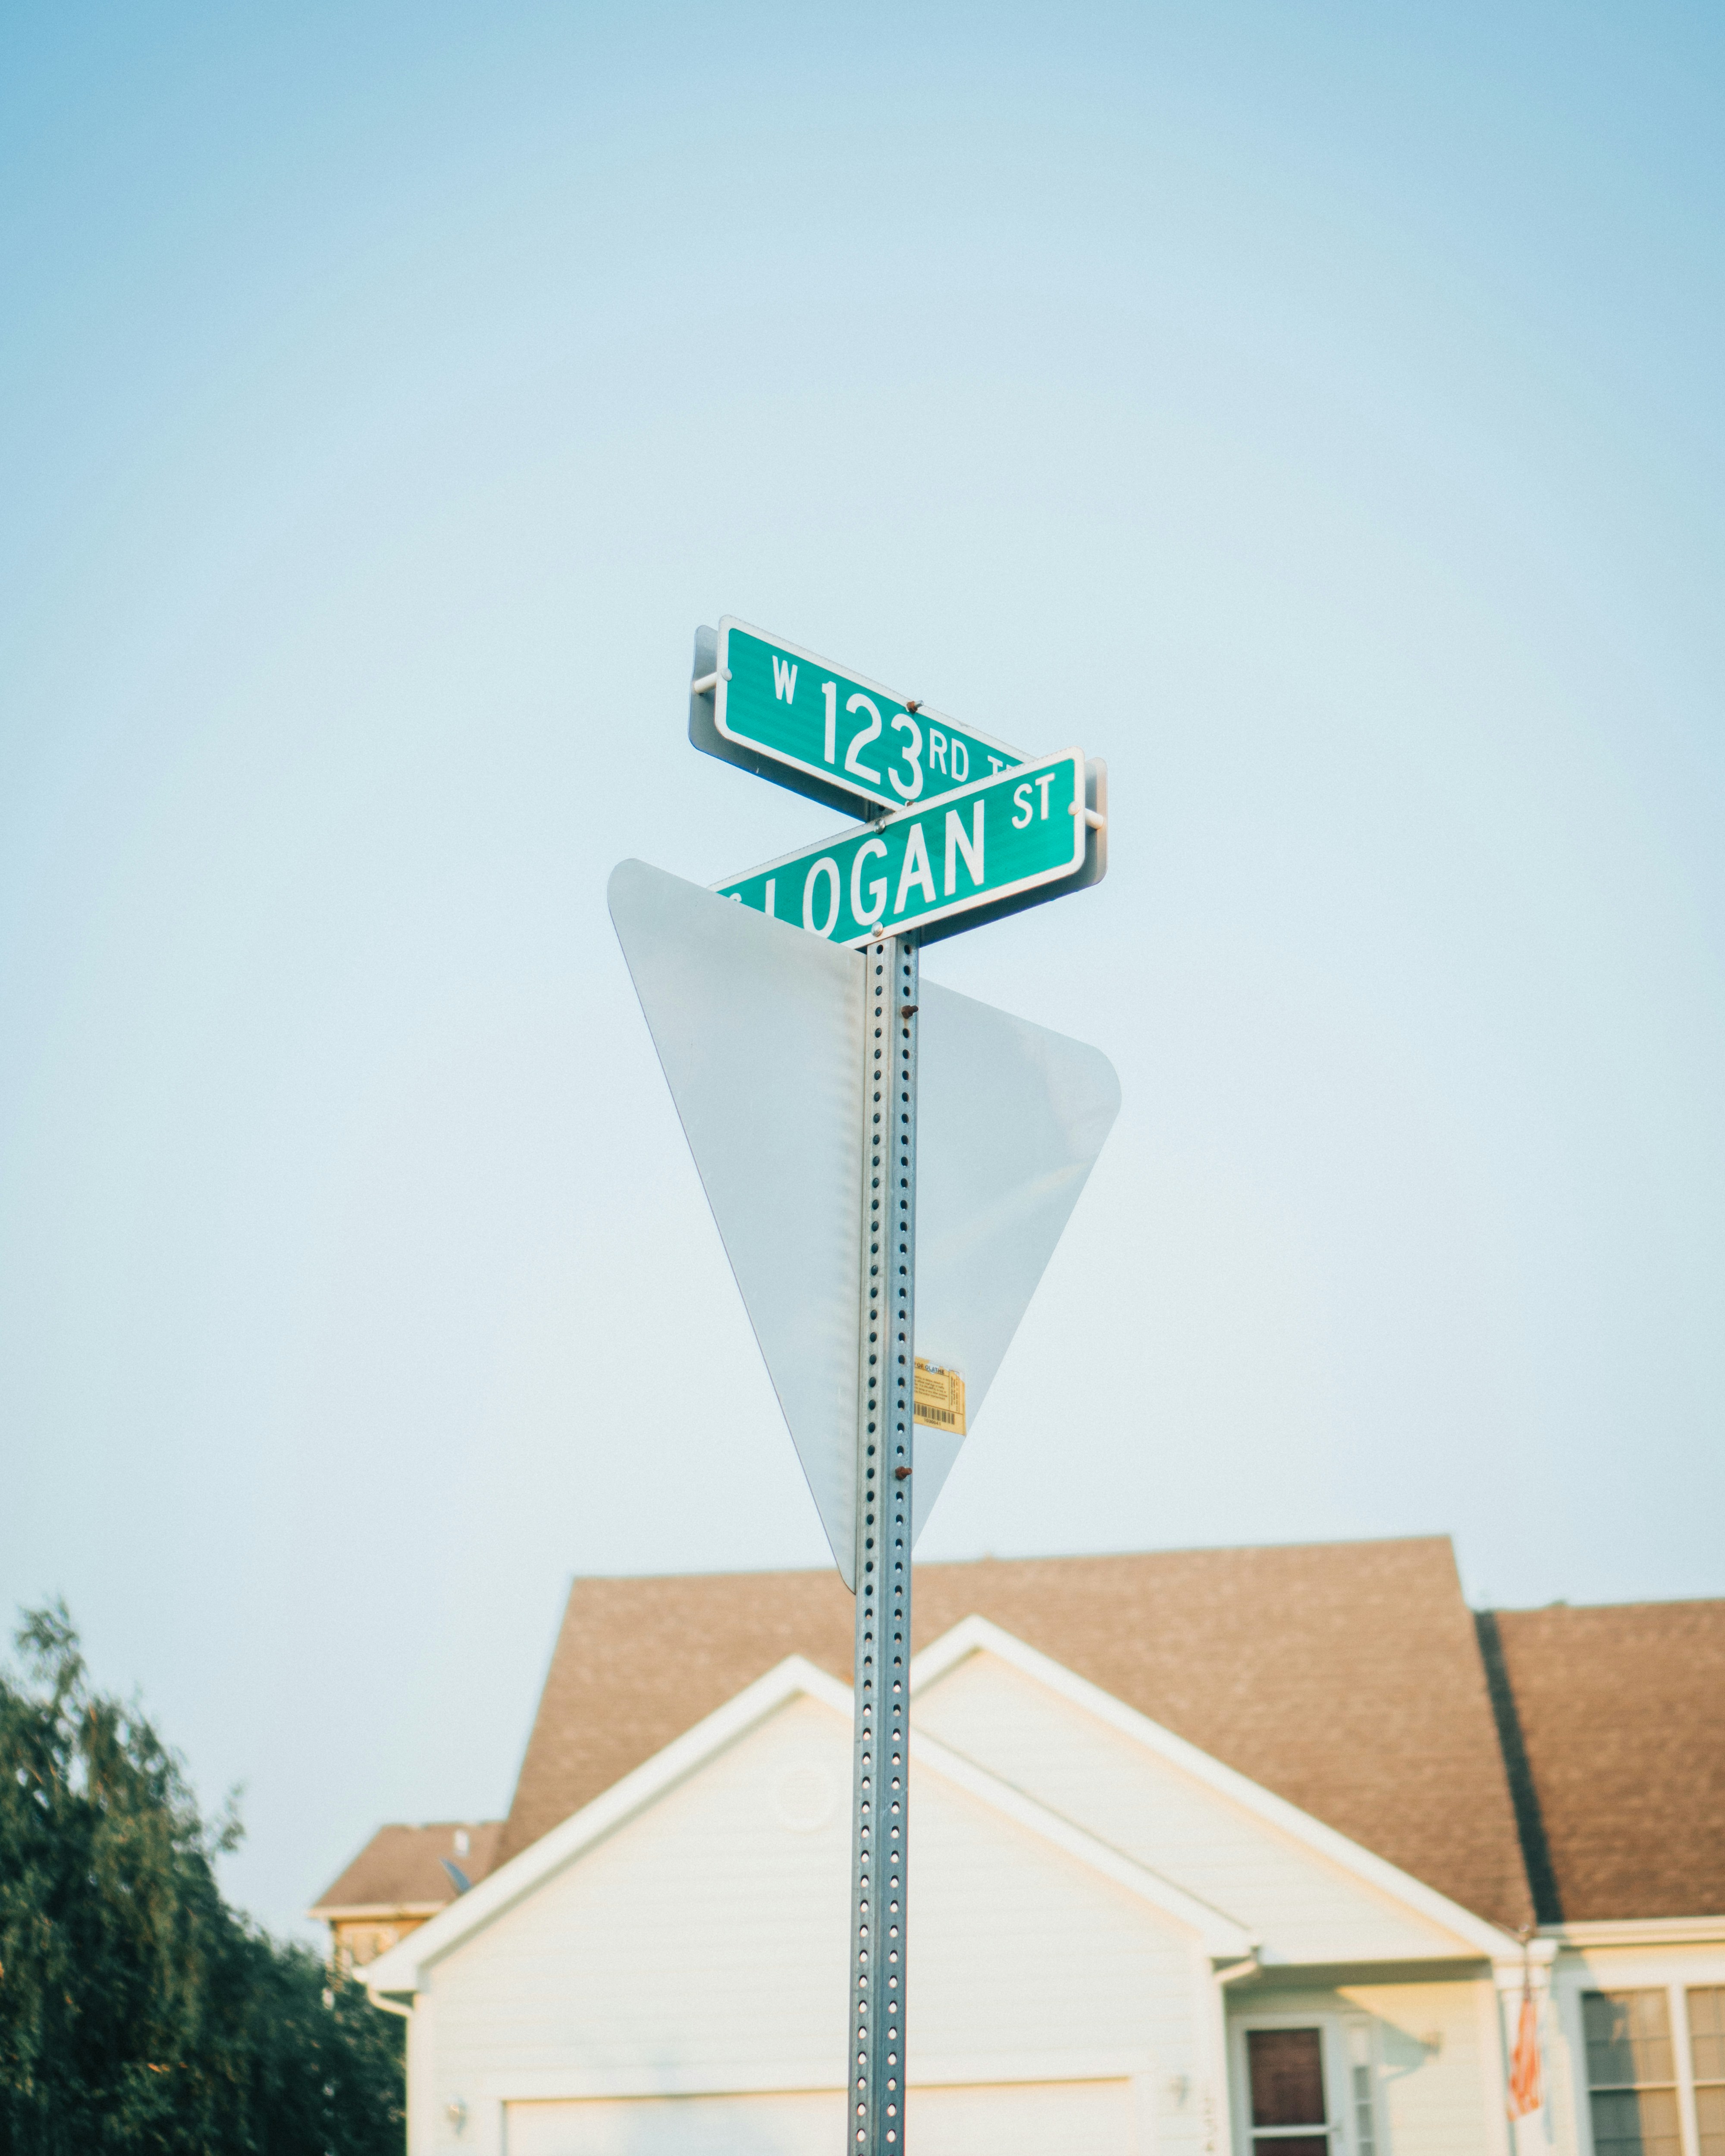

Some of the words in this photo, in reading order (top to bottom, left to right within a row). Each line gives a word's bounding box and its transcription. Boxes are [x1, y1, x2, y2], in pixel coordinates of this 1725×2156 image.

[772, 654, 798, 705] W
[821, 680, 969, 801] 123RD
[1011, 772, 1055, 830] ST
[925, 1365, 945, 1375] OLATHE
